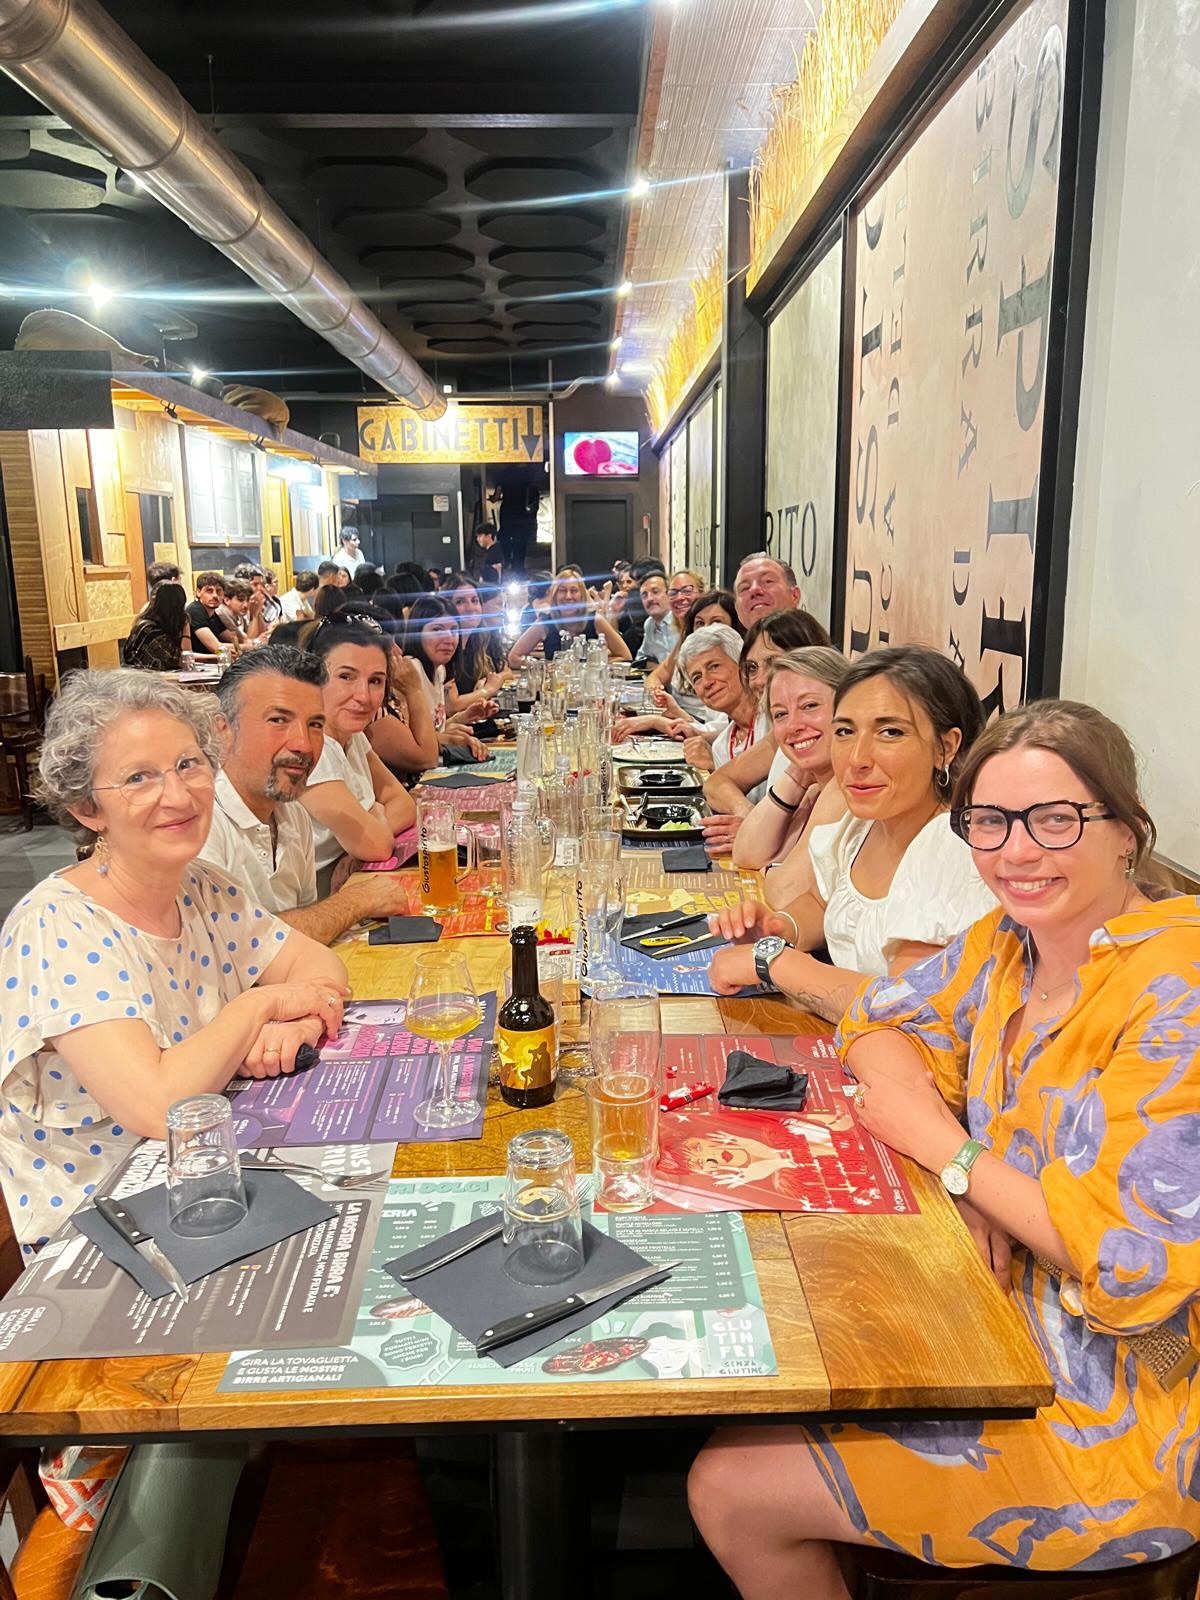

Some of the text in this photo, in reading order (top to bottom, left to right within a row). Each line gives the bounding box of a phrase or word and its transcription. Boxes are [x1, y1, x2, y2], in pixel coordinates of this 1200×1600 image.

[359, 417, 519, 452] GABINETTI
[419, 827, 431, 894] Giustospirito
[575, 880, 588, 977] Giustospirito
[418, 1180, 489, 1194] DOLCI
[347, 1202, 362, 1214] LA
[336, 1215, 360, 1251] NOSTRA
[312, 1262, 326, 1278] NON
[326, 1252, 350, 1284] BIRRA
[22, 1306, 46, 1333] GIRA LA
[712, 1320, 752, 1332] GLU
[713, 1332, 754, 1344] TIN
[720, 1344, 754, 1358] FRI
[241, 1356, 358, 1366] GIRA LA TOVAGLIETTA
[247, 1366, 282, 1375] GUSTA
[285, 1366, 298, 1374] LE
[299, 1365, 346, 1374] NOSTRE
[232, 1374, 342, 1384] BIRRE ARTIGIANALI
